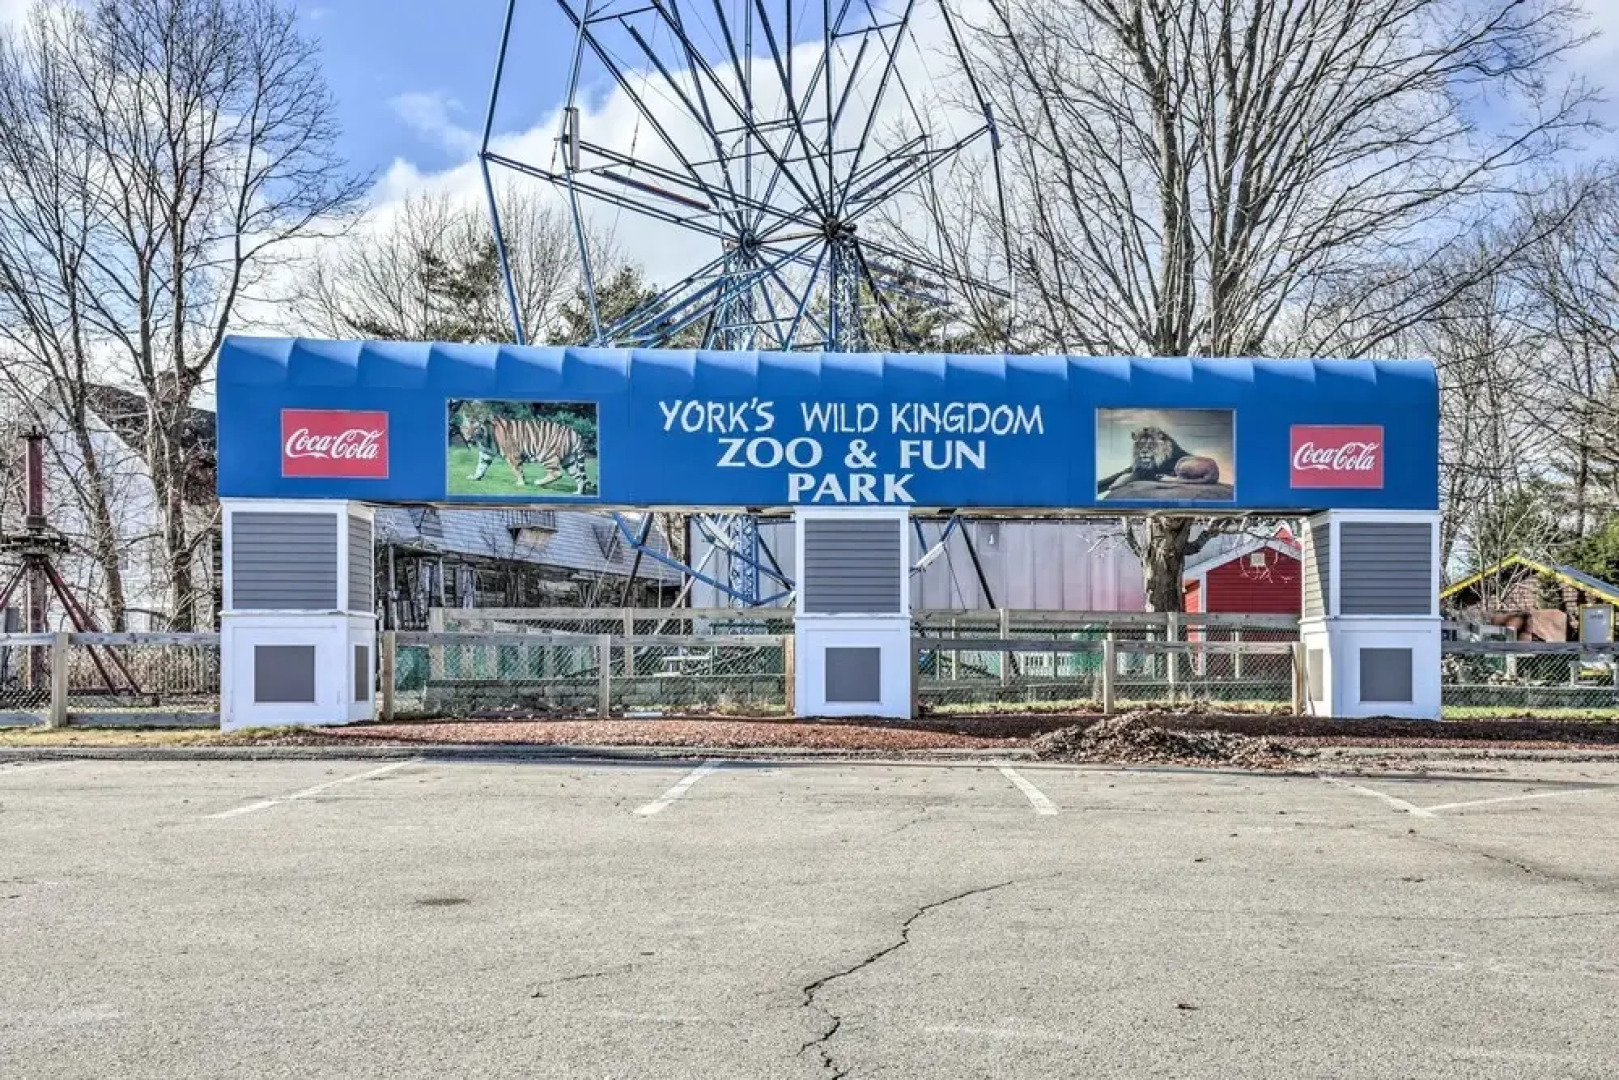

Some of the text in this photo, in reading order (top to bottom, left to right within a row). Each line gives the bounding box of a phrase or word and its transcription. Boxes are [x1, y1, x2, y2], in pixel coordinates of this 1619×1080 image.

[659, 398, 1044, 435] YORK'S WILD KINGDOM
[285, 427, 385, 459] Coca-Cola
[717, 437, 986, 470] ZOO & FUN
[788, 473, 916, 503] PARK
